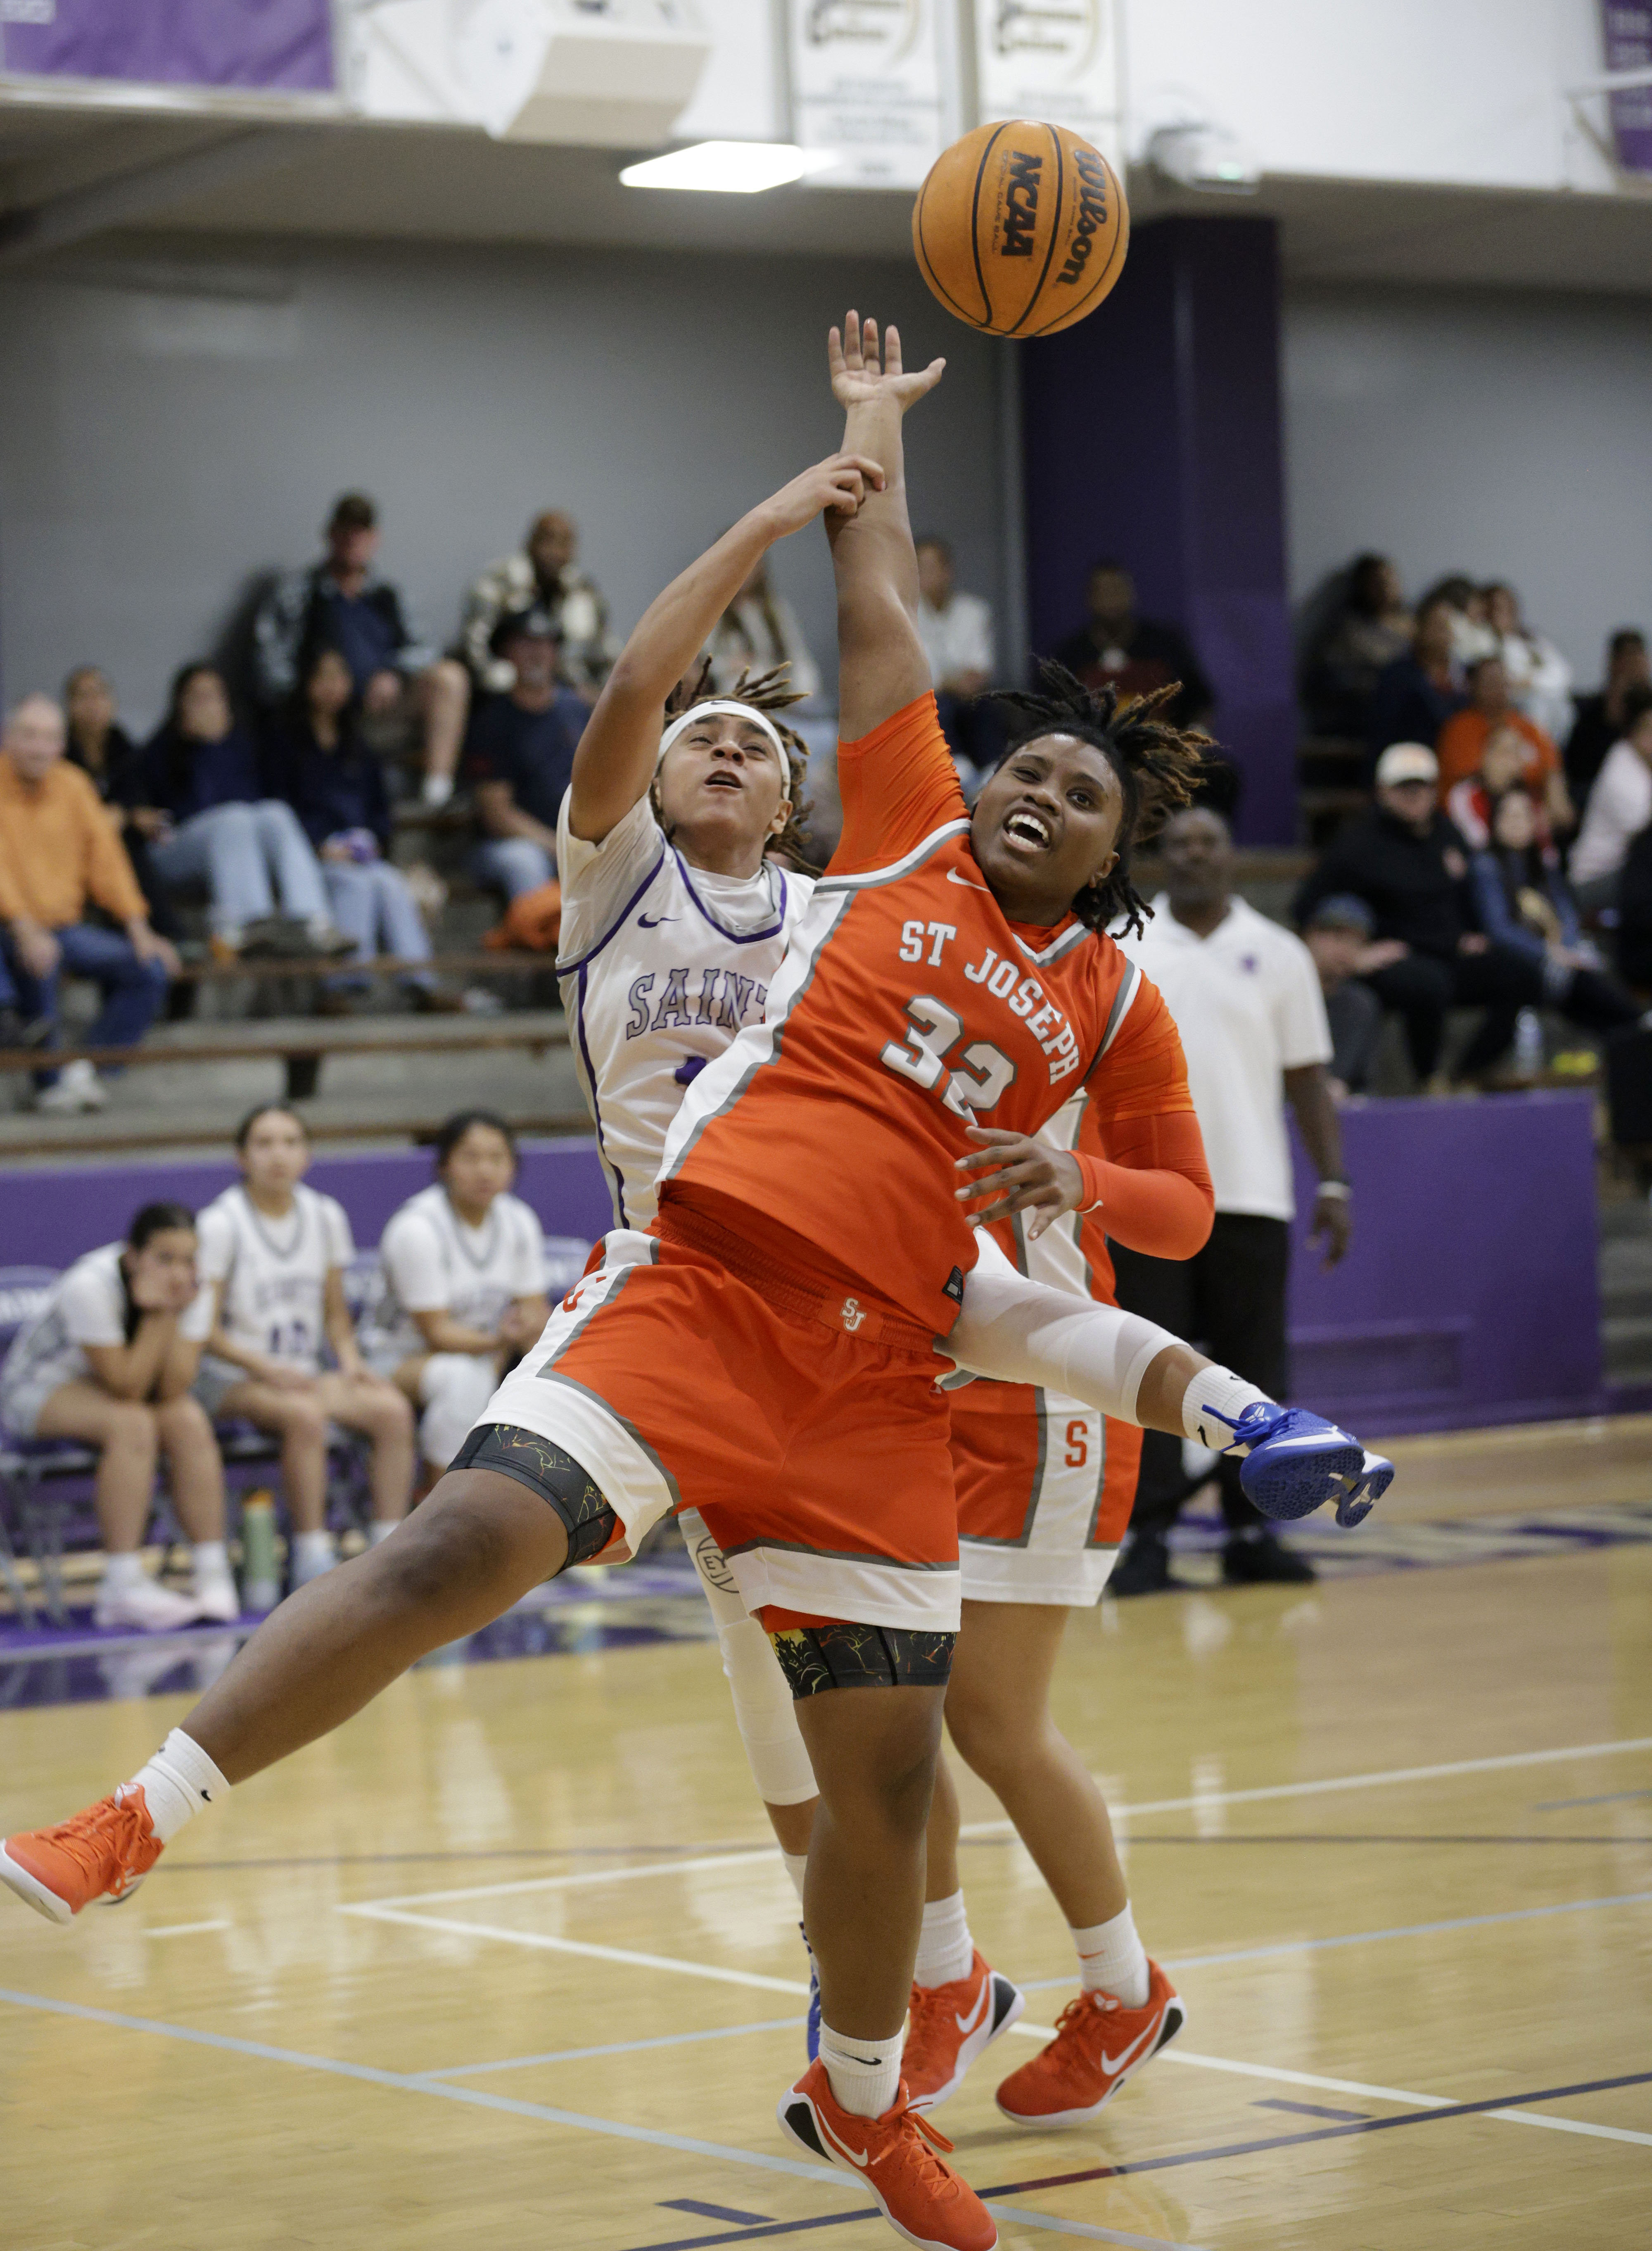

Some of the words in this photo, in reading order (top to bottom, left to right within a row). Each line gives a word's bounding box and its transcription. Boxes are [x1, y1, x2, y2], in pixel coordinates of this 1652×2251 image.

[1001, 150, 1043, 256] NCAA
[1056, 149, 1108, 285] Wilson
[878, 994, 1018, 1127] 32
[899, 920, 957, 967] ST
[964, 946, 1080, 1085] JOSEPH
[1065, 1420, 1088, 1468] S
